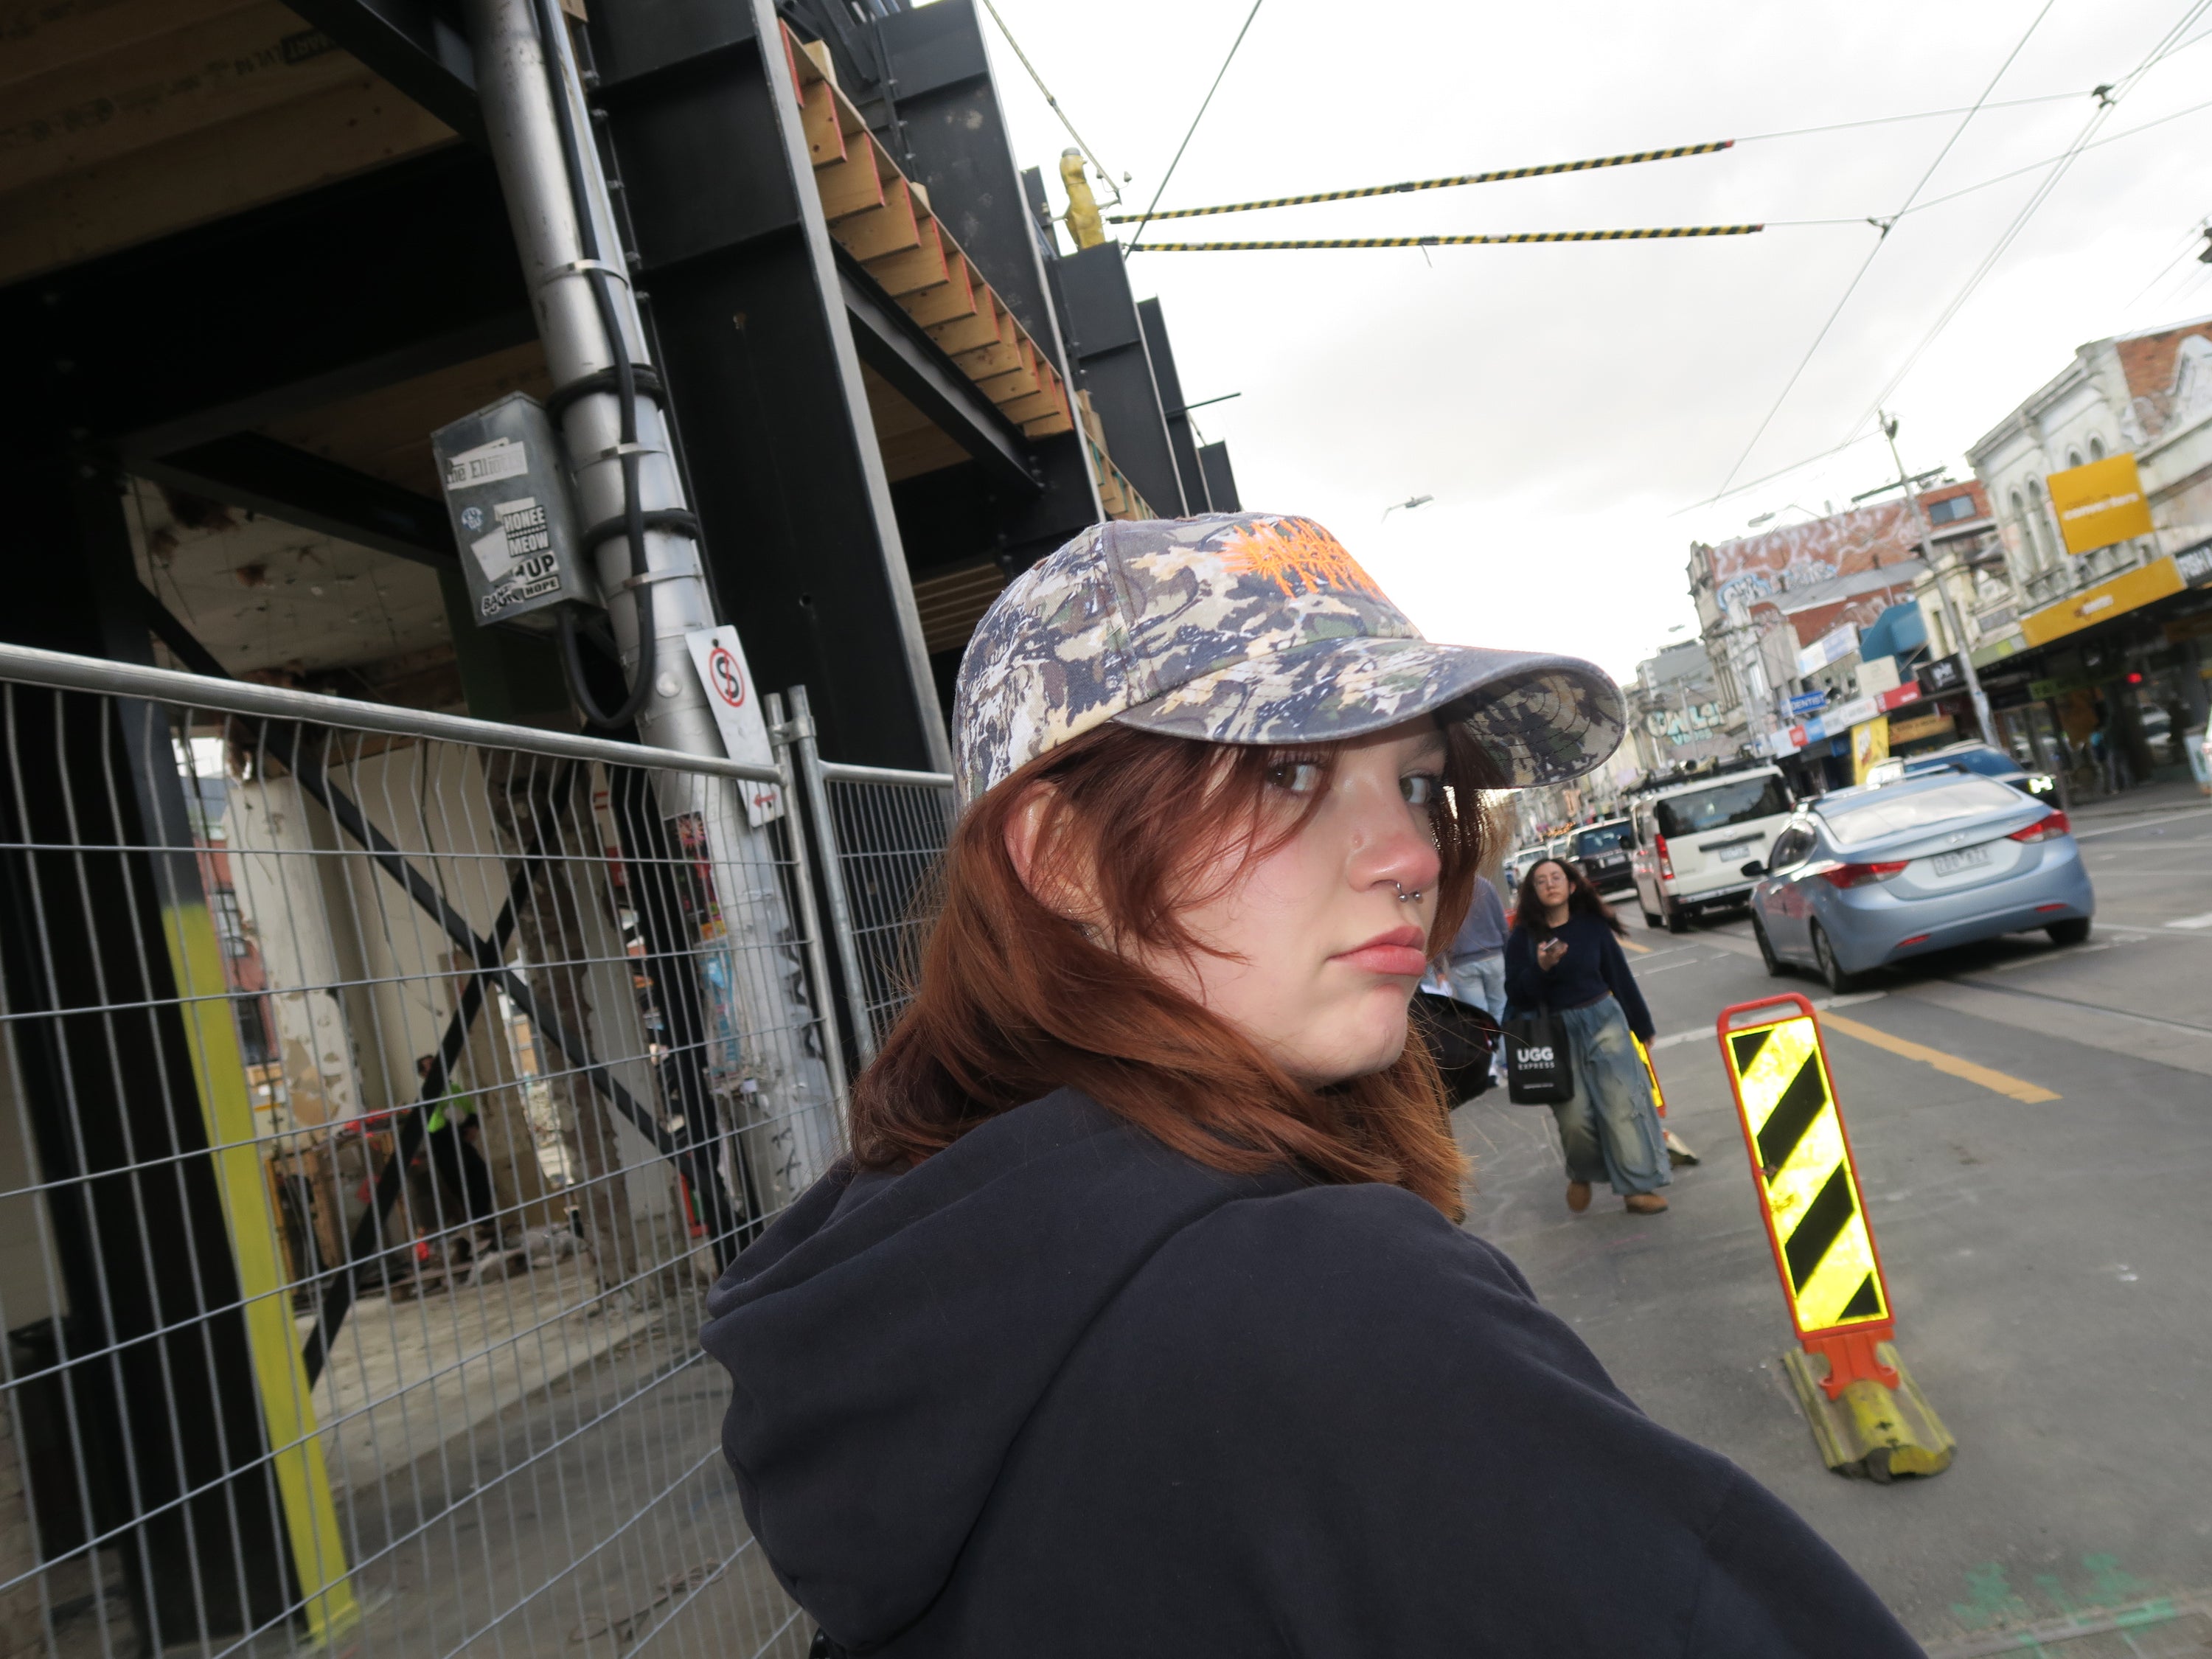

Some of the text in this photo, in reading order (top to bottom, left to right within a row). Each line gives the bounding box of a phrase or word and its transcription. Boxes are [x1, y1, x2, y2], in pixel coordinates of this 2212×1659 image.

[508, 530, 549, 557] MEOW
[525, 580, 557, 595] HOPE
[716, 656, 740, 698] S
[1792, 695, 1825, 710] DENTIST
[1517, 1046, 1554, 1062] UGG
[1517, 1062, 1555, 1071] EXPRESS
